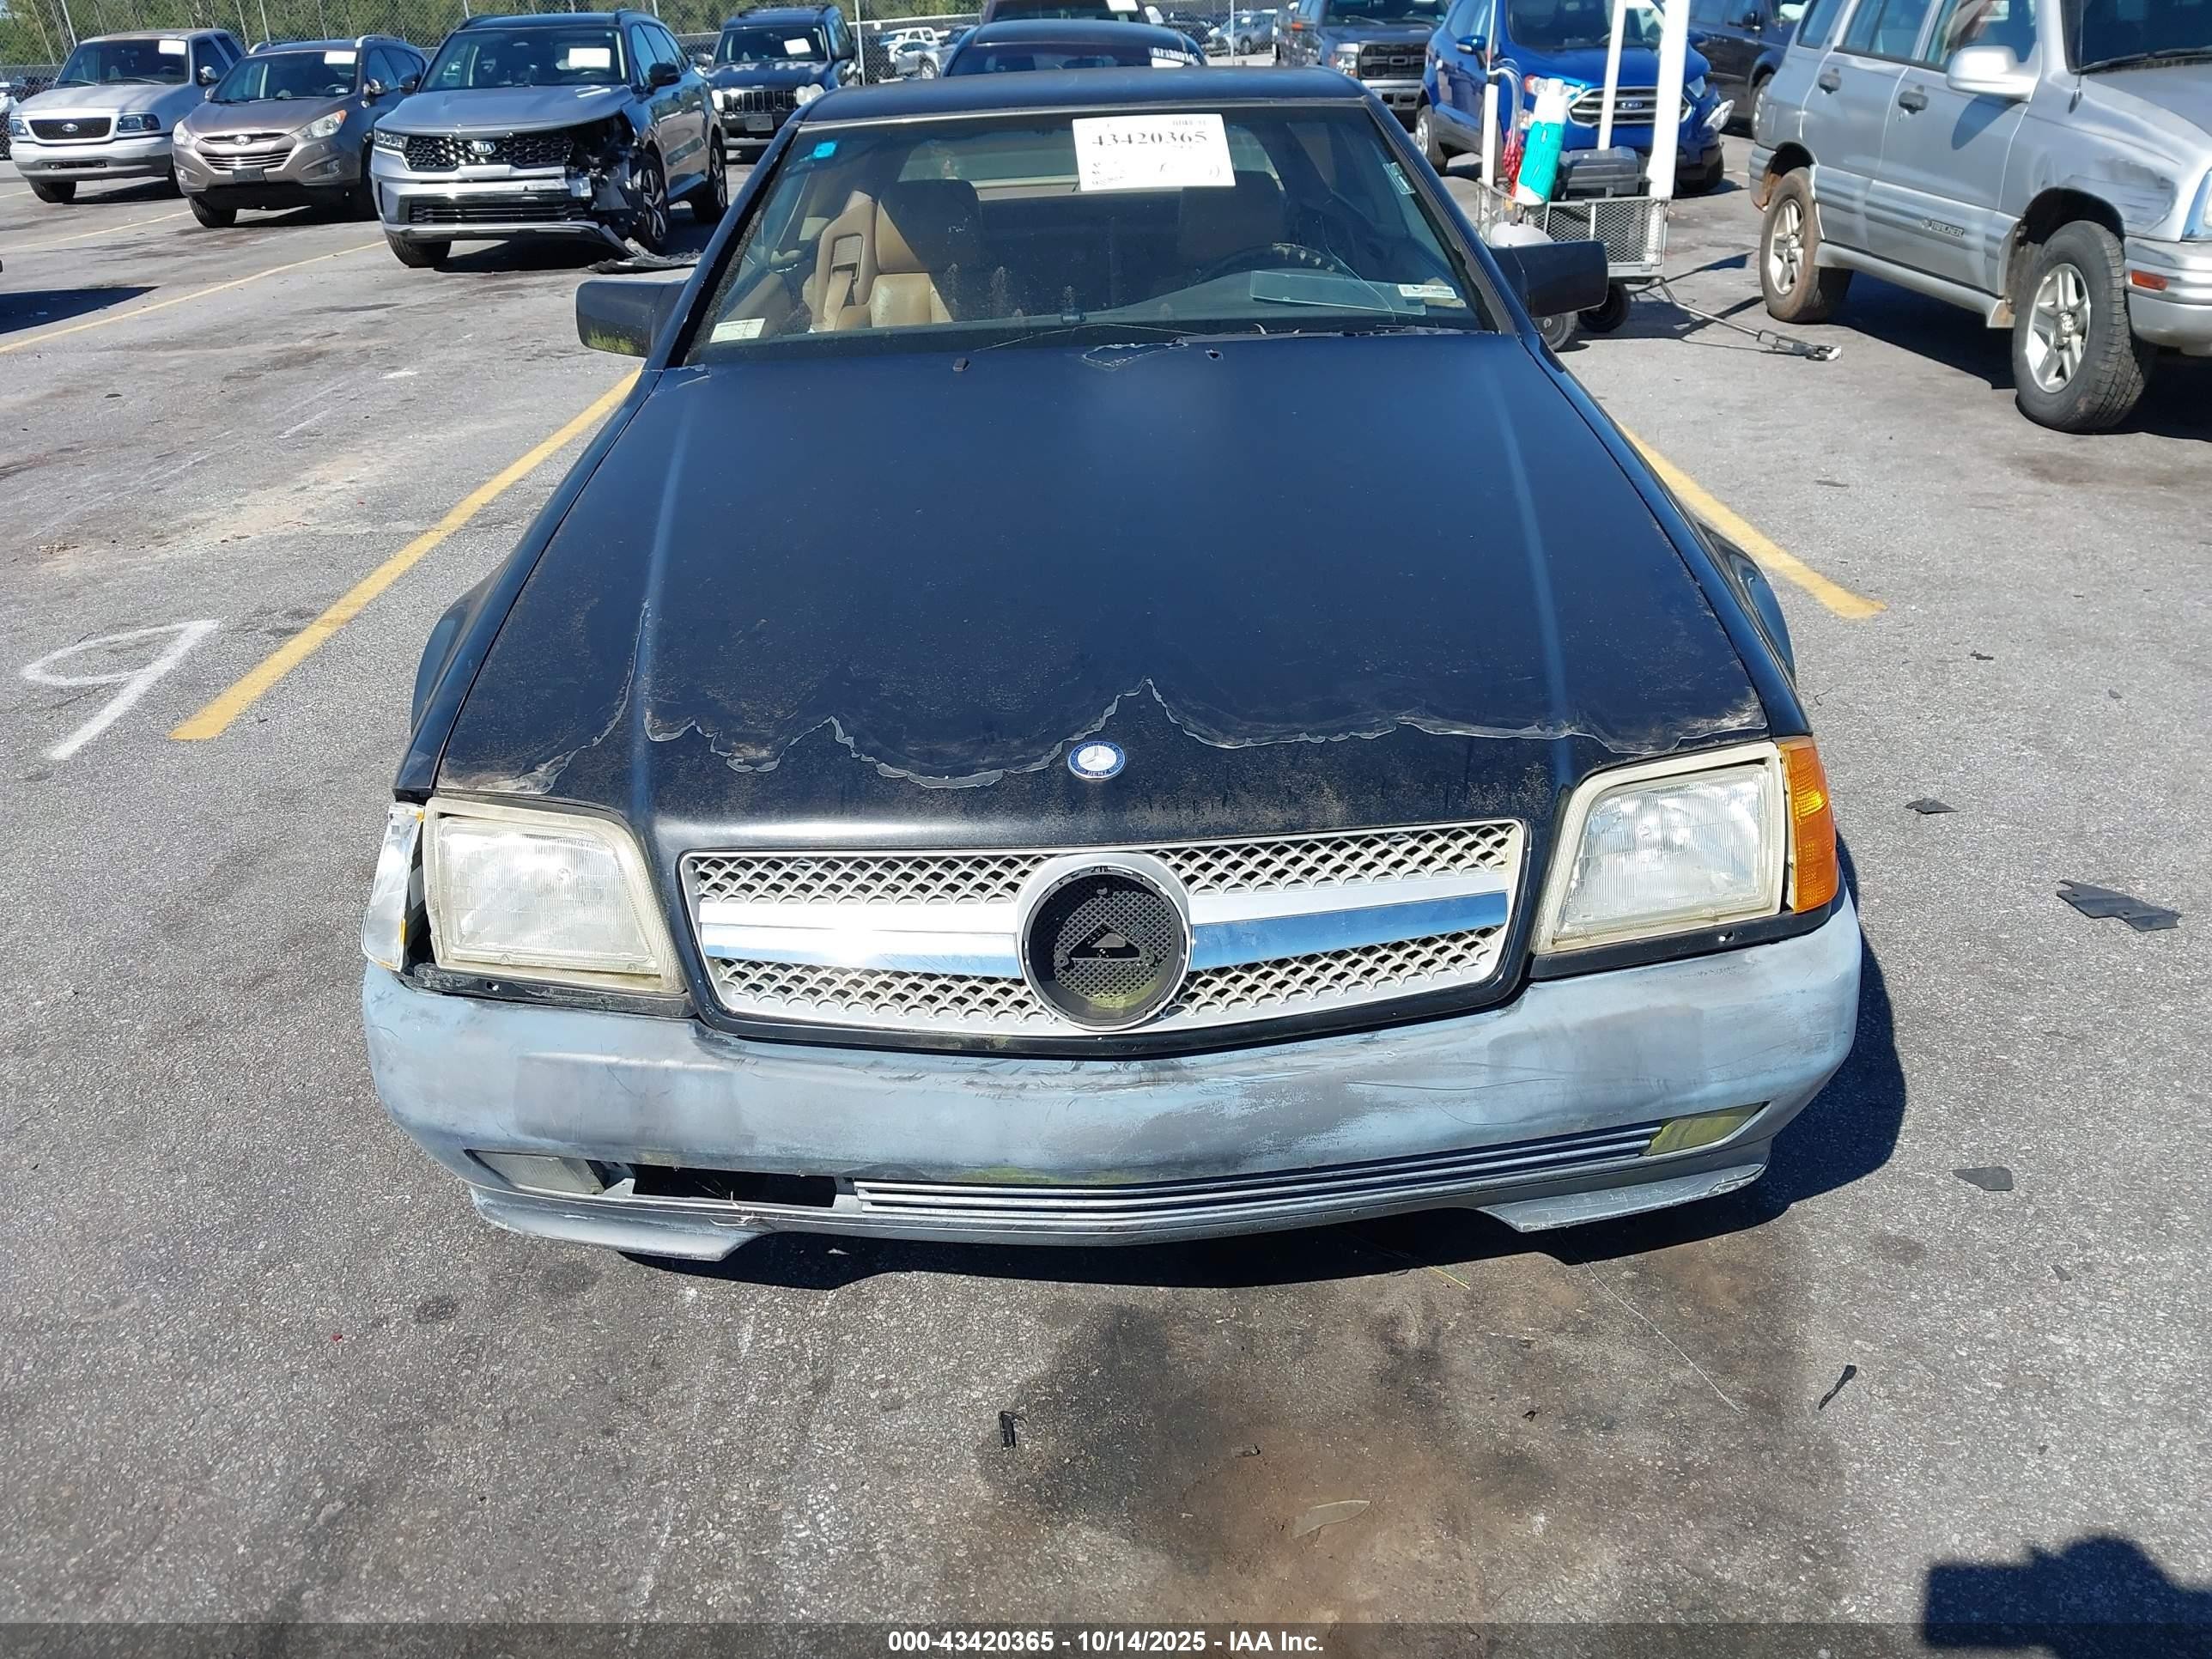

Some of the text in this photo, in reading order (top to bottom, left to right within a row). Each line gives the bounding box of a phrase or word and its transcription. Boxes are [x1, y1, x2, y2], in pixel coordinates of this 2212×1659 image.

[1360, 55, 1425, 66] FOR
[1092, 131, 1207, 146] 43420365
[472, 141, 494, 153] KIA
